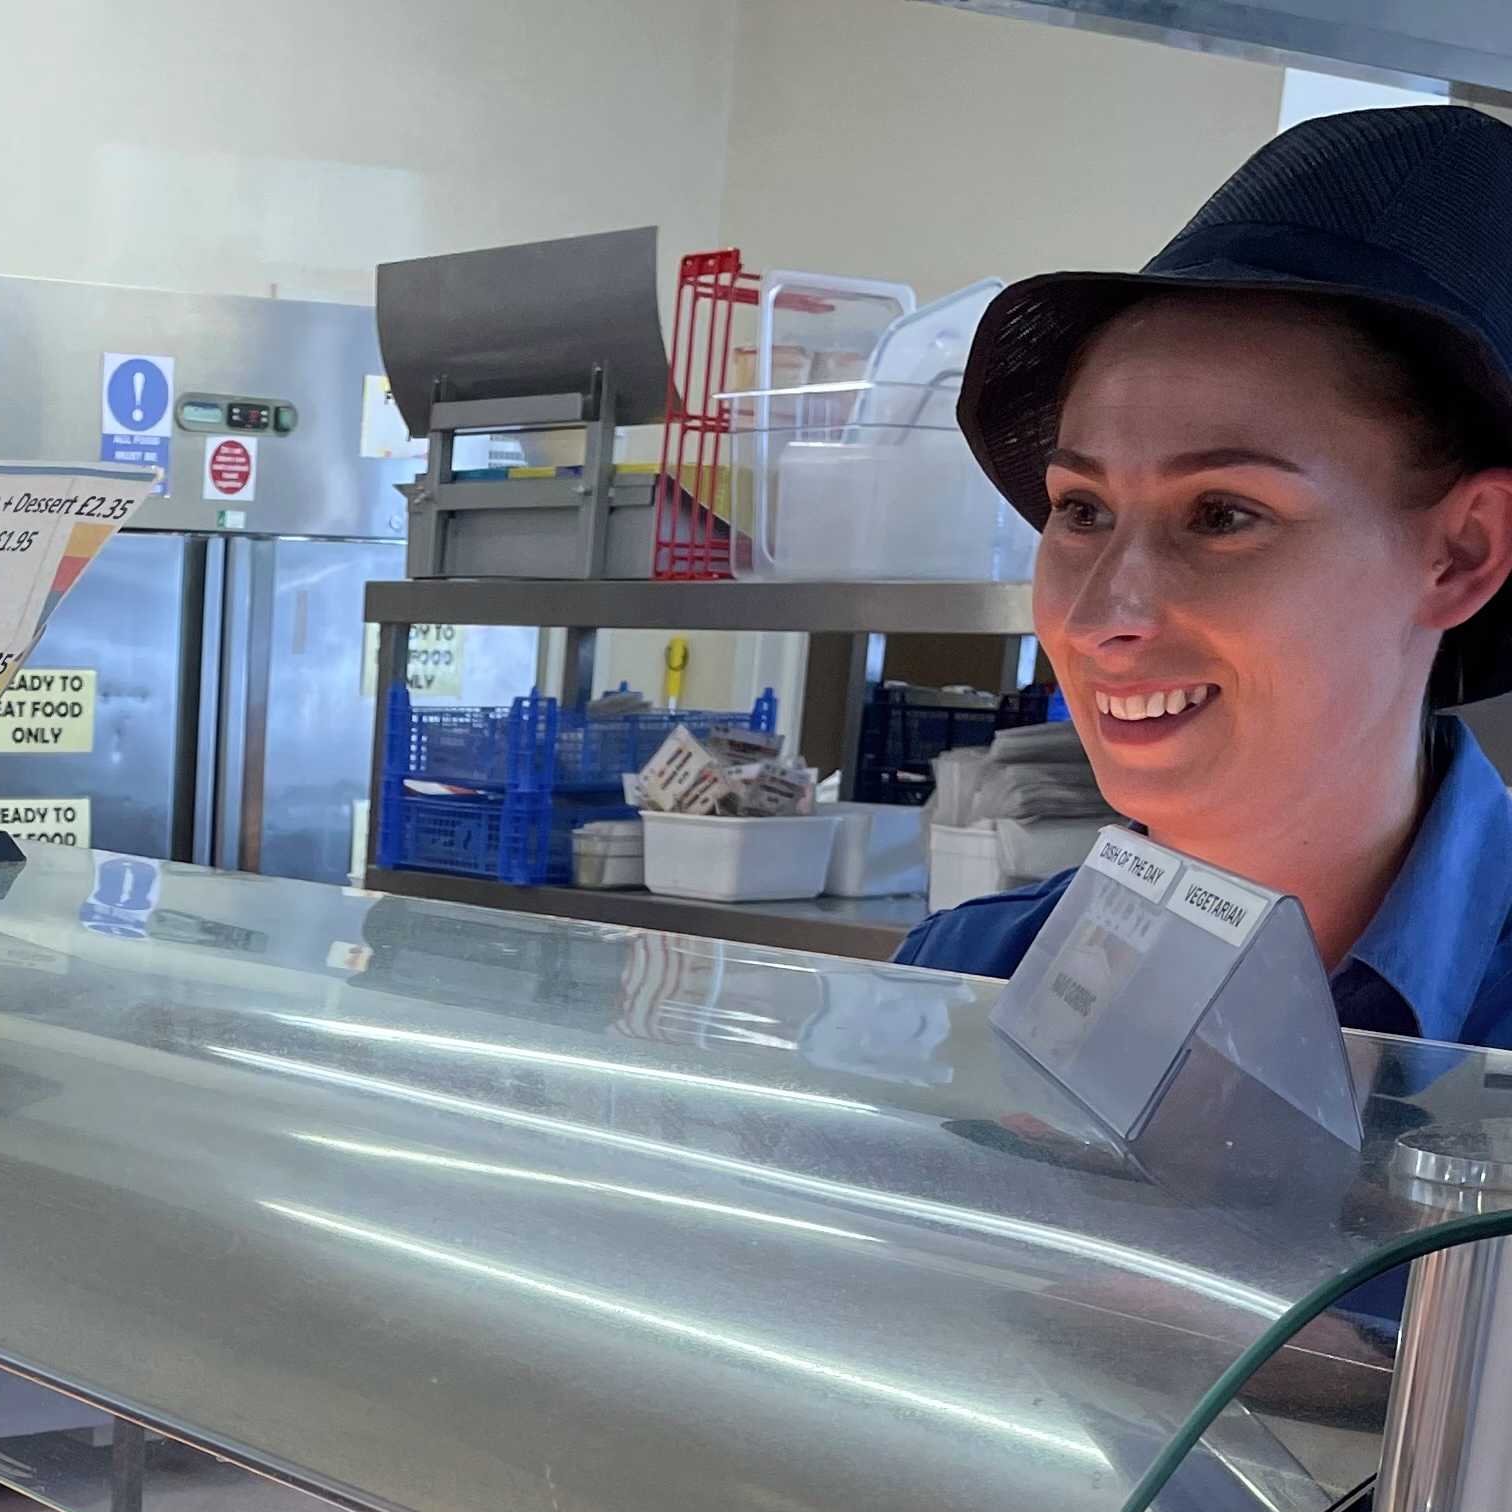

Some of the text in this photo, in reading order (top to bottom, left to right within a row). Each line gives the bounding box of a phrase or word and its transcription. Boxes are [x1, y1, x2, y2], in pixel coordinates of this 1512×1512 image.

[3, 495, 14, 511] +
[13, 493, 78, 515] Dessert
[75, 496, 136, 520] £2.35
[60, 675, 83, 692] TO
[31, 702, 83, 718] FOOD
[12, 727, 63, 744] ONLY
[54, 807, 76, 823] TO
[1100, 842, 1165, 886] DISH OF THE DAY
[1184, 884, 1246, 928] VEGETARIAN
